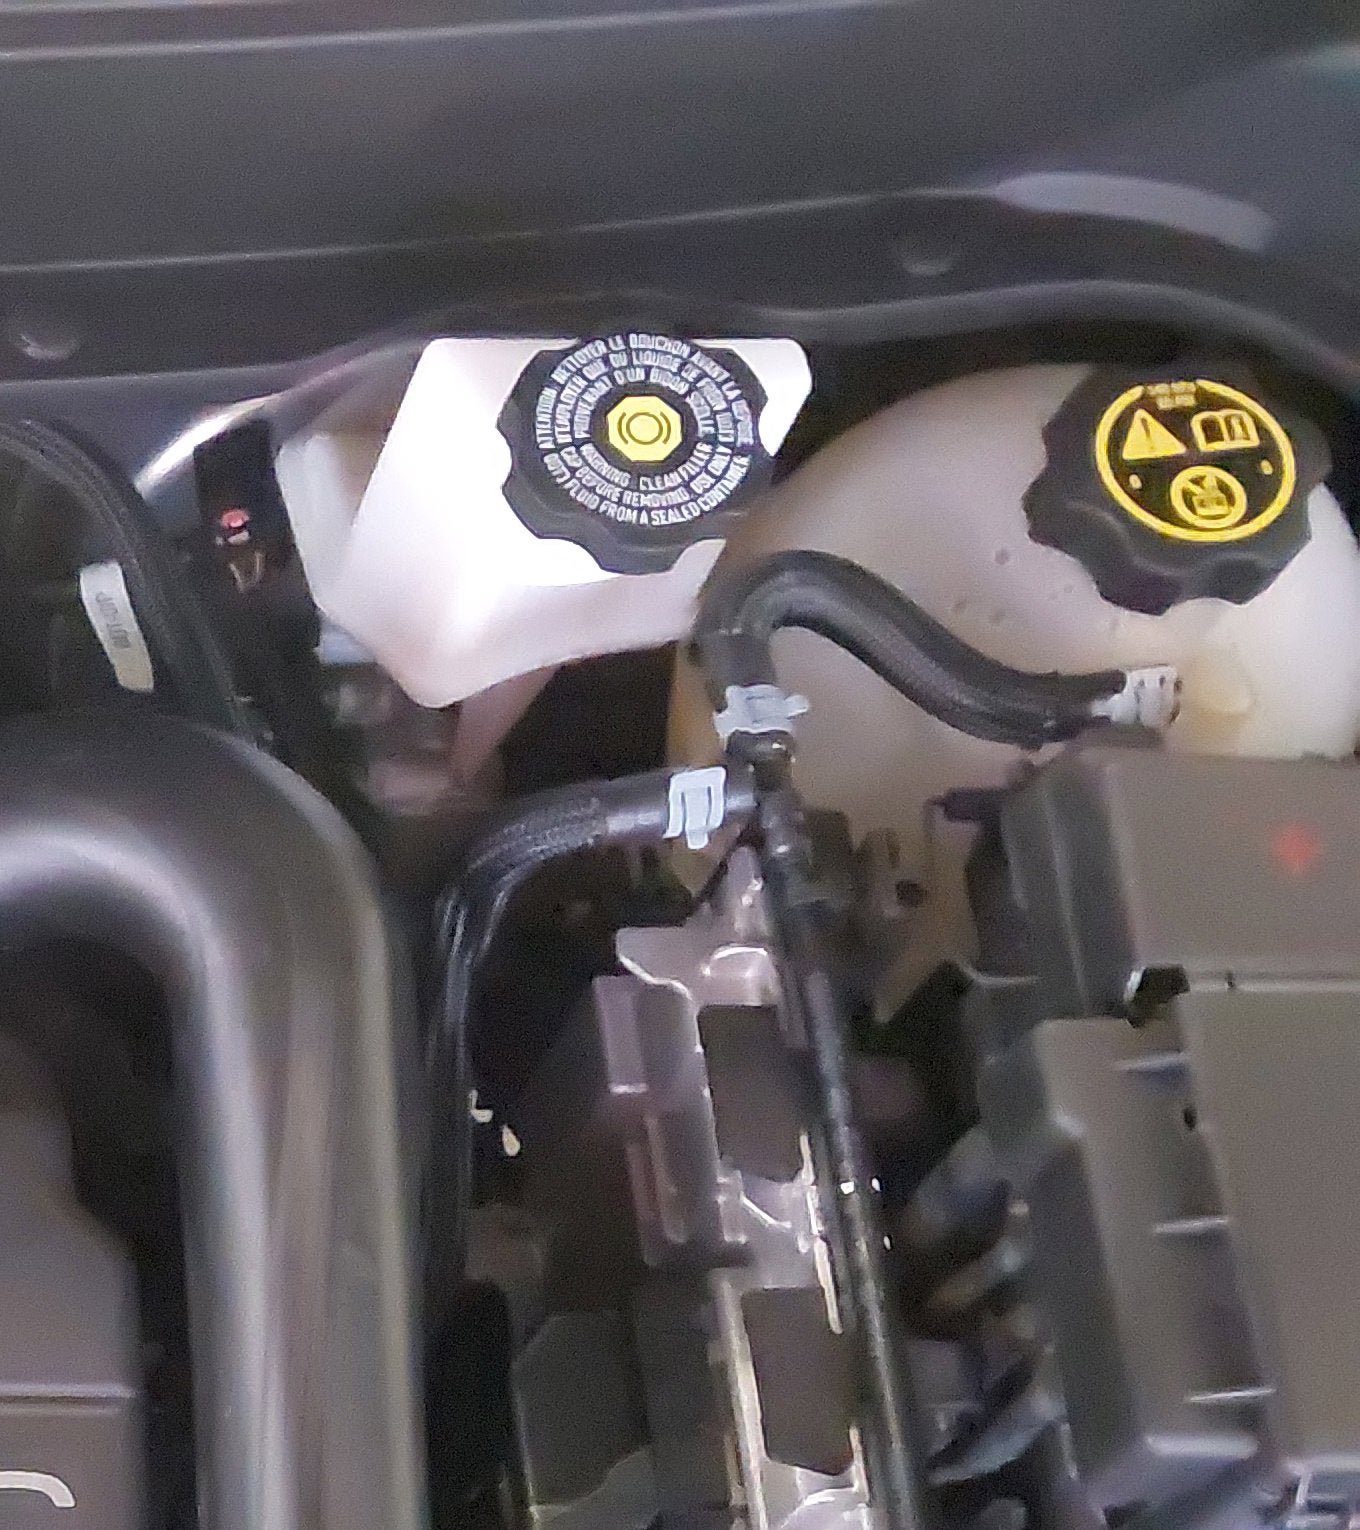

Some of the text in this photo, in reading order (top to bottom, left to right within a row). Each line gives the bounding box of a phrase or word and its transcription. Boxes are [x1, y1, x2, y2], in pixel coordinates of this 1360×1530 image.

[563, 478, 600, 509] FLUID
[599, 500, 637, 523] FROM
[640, 509, 649, 524] A
[651, 501, 700, 525] SEALED
[697, 454, 751, 512] CONTAINER
[575, 466, 623, 502] BEFORE
[708, 445, 732, 476] ONLY
[640, 470, 682, 490] CLEAN
[678, 442, 712, 482] FILLER
